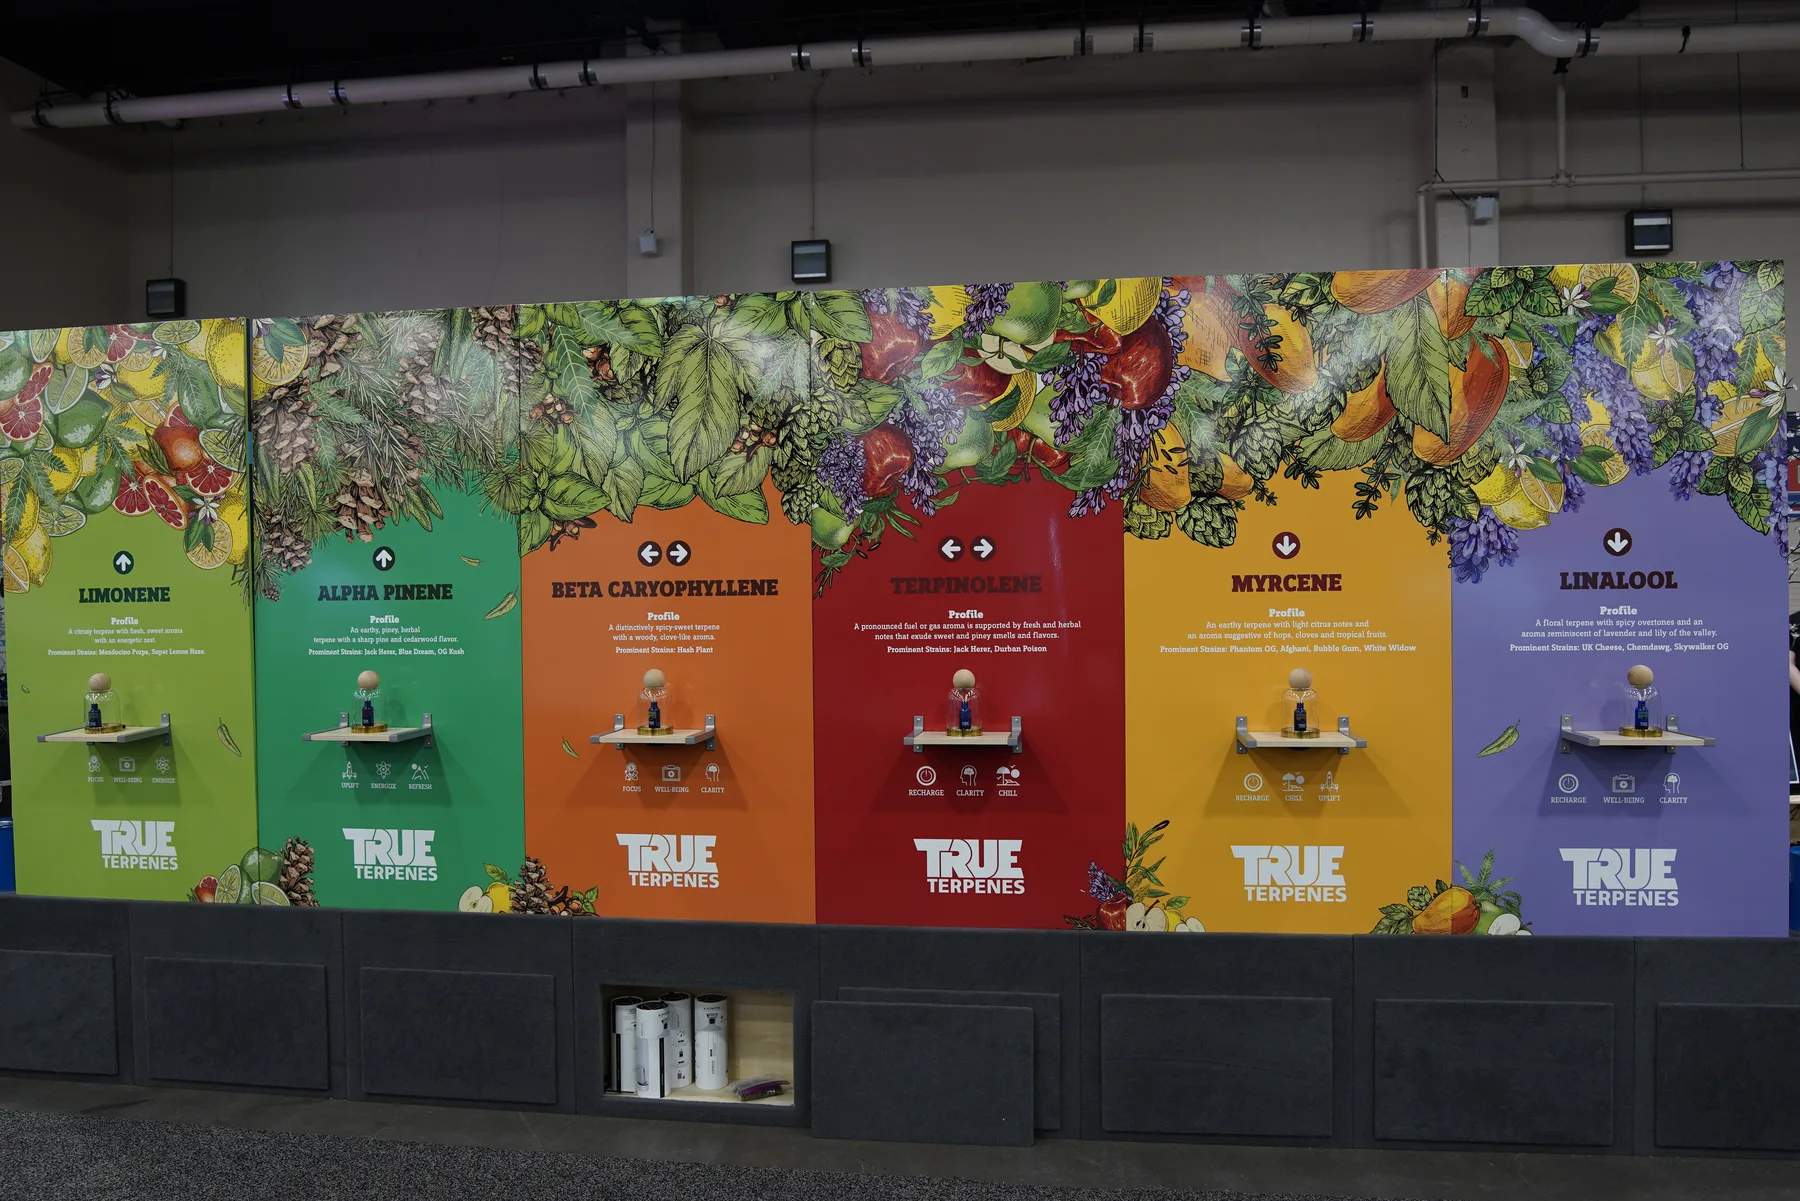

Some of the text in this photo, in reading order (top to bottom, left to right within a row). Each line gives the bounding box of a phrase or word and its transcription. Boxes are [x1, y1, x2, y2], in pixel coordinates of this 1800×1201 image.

[552, 579, 778, 598] BETA CARYOPHYLLENE
[890, 576, 1042, 594] TERPINOLENE
[1231, 574, 1342, 592] MYRCENE
[1560, 571, 1679, 590] LINALOOL
[79, 587, 171, 603] LIMONENE
[318, 584, 453, 601] ALPHA PINENE
[647, 612, 680, 620] Profile
[948, 610, 984, 618] Profile
[1269, 608, 1306, 617] Profile
[1600, 606, 1637, 615] Profile
[110, 617, 139, 625] Profile
[370, 615, 399, 623] Profile
[861, 623, 902, 631] pronounced
[975, 622, 1010, 630] supported
[1219, 621, 1241, 629] earthy
[1244, 622, 1271, 630] terpene
[1293, 621, 1308, 629] light
[1616, 619, 1635, 627] spicy
[615, 624, 654, 632] distinctively
[656, 624, 693, 632] spicy-sweet
[1224, 632, 1261, 640] suggestive
[1274, 632, 1293, 640] hops,
[1337, 631, 1364, 639] tropical
[1367, 630, 1387, 638] fruits.
[1655, 629, 1666, 637] lily
[1694, 629, 1716, 637] valley.
[1265, 645, 1278, 653] OG,
[1281, 645, 1311, 653] Afghani,
[1627, 643, 1672, 652] Chemdawg,
[1674, 643, 1715, 652] Skywalker
[90, 819, 177, 856] TRUE
[342, 828, 437, 866] TRUE
[615, 833, 719, 873] TRUE
[102, 855, 178, 870] TERPENES
[913, 839, 1024, 878] TRUE
[1230, 845, 1346, 886] TRUE
[354, 865, 438, 881] TERPENES
[1559, 848, 1678, 890] TRUE
[628, 872, 719, 888] TERPENES
[927, 879, 1025, 895] TERPENES
[1244, 886, 1347, 902] TERPENES
[1573, 890, 1679, 907] TERPENES
